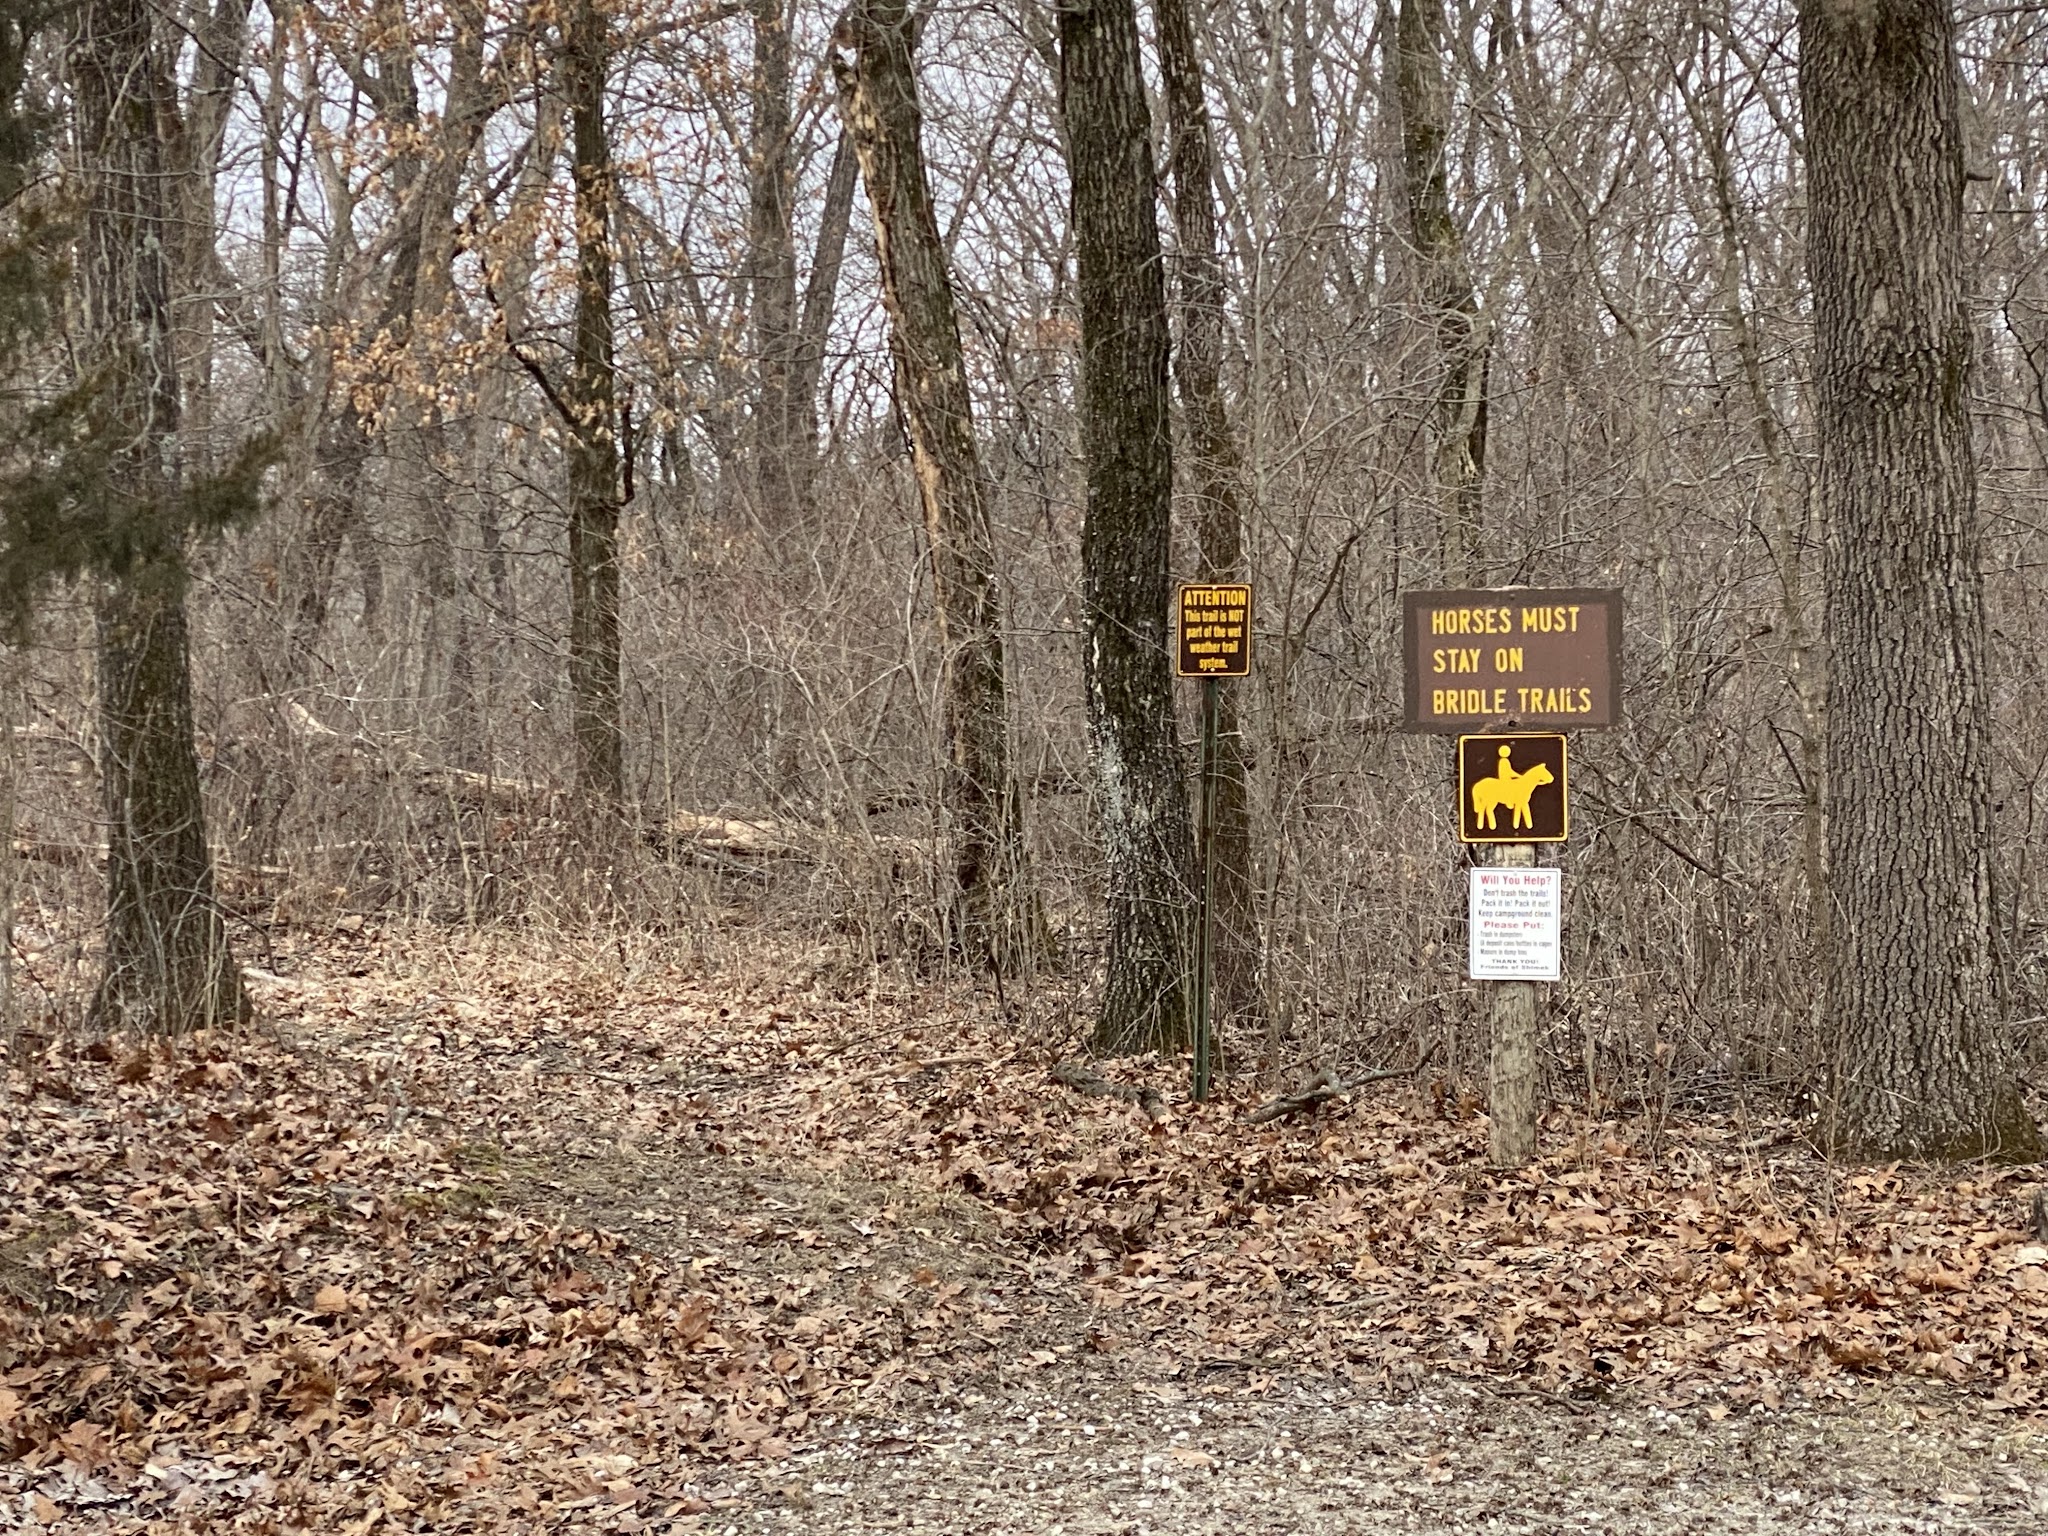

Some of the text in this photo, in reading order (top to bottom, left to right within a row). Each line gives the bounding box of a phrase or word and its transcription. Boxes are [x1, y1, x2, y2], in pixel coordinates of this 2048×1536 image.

[1184, 590, 1246, 606] ATTENTION
[1185, 610, 1244, 622] This trail is NOT
[1432, 606, 1579, 634] HORSES MUST
[1187, 626, 1241, 640] part of the wet
[1190, 641, 1238, 653] weather trail
[1199, 657, 1228, 671] system.
[1433, 648, 1523, 673] STAY ON
[1433, 687, 1592, 714] BRIDLE TRAILS
[1481, 875, 1551, 886] Will You Help?
[1501, 889, 1516, 897] trash
[1519, 889, 1528, 897] the
[1530, 889, 1548, 897] trails!
[1479, 910, 1493, 918] Keep
[1495, 910, 1532, 919] campground
